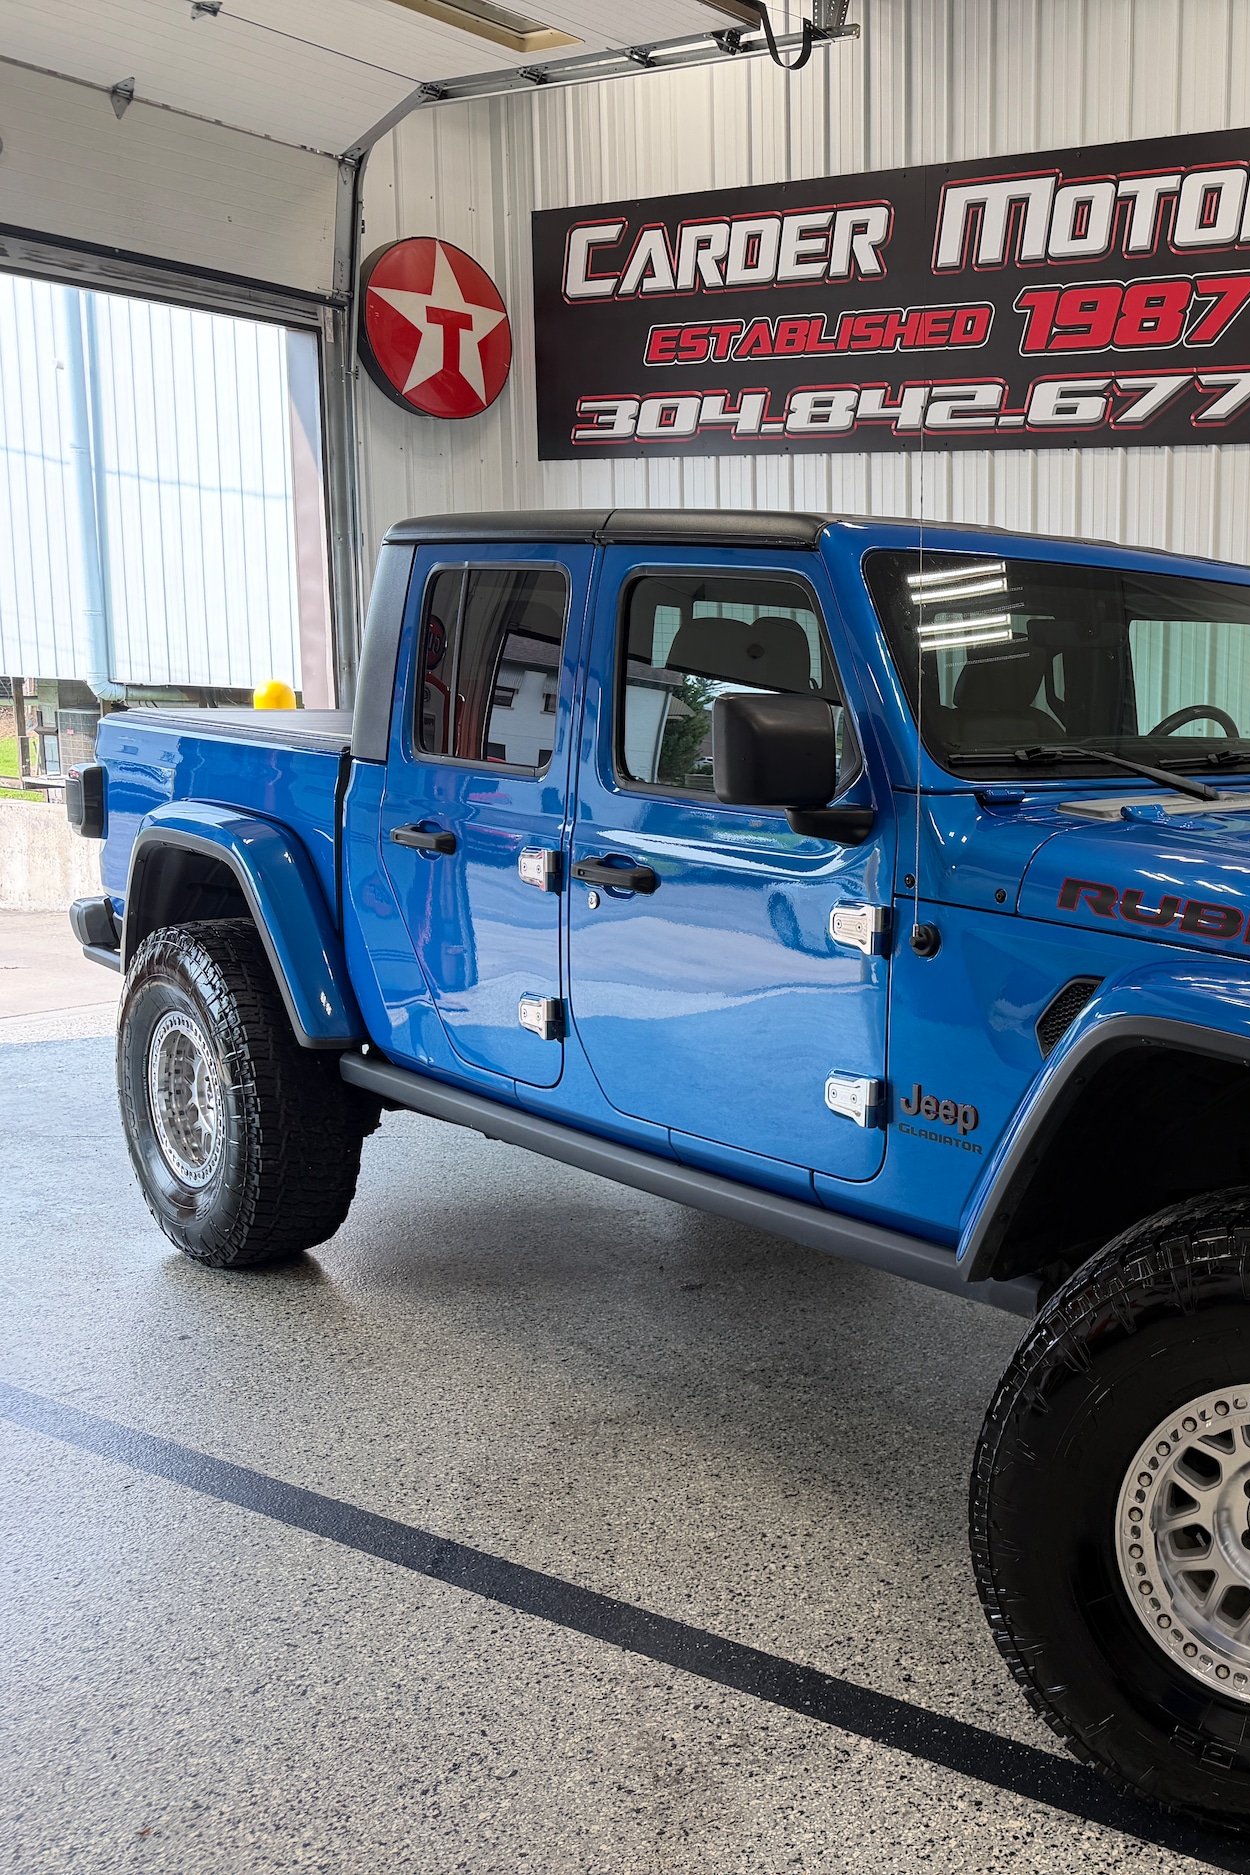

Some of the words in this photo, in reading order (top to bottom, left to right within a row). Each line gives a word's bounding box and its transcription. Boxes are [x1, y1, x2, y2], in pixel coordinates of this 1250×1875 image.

[562, 199, 894, 304] CARDER
[425, 305, 474, 373] T
[644, 302, 995, 366] ESTABLISHED
[898, 1122, 983, 1155] GLADIATOR
[900, 1083, 979, 1136] Jeep
